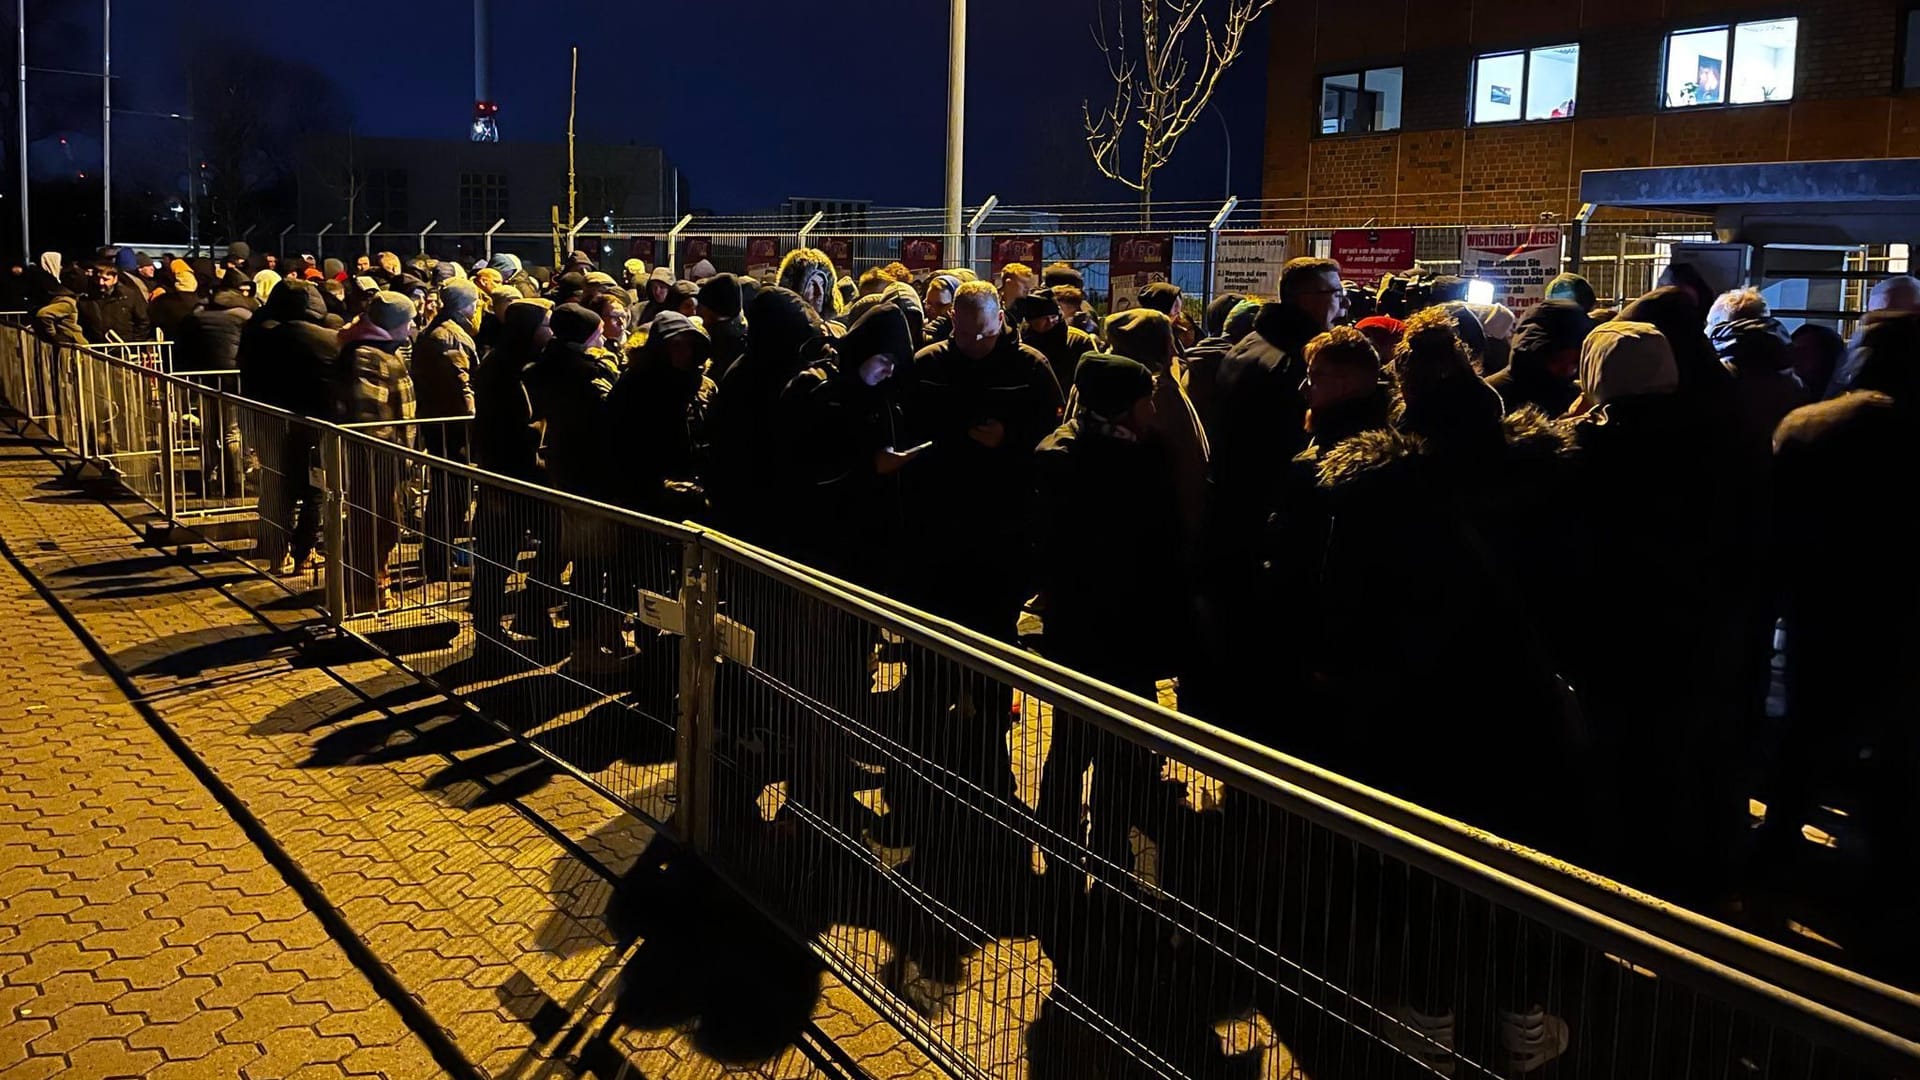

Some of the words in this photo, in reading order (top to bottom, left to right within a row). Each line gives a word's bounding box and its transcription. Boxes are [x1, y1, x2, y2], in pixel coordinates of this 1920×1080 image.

[1467, 233, 1514, 247] WICHTIGER
[1528, 258, 1540, 267] Sie
[1511, 267, 1529, 276] dass
[1531, 267, 1544, 276] Sie
[1545, 267, 1557, 276] als
[1523, 276, 1544, 285] nicht
[1512, 286, 1524, 294] als
